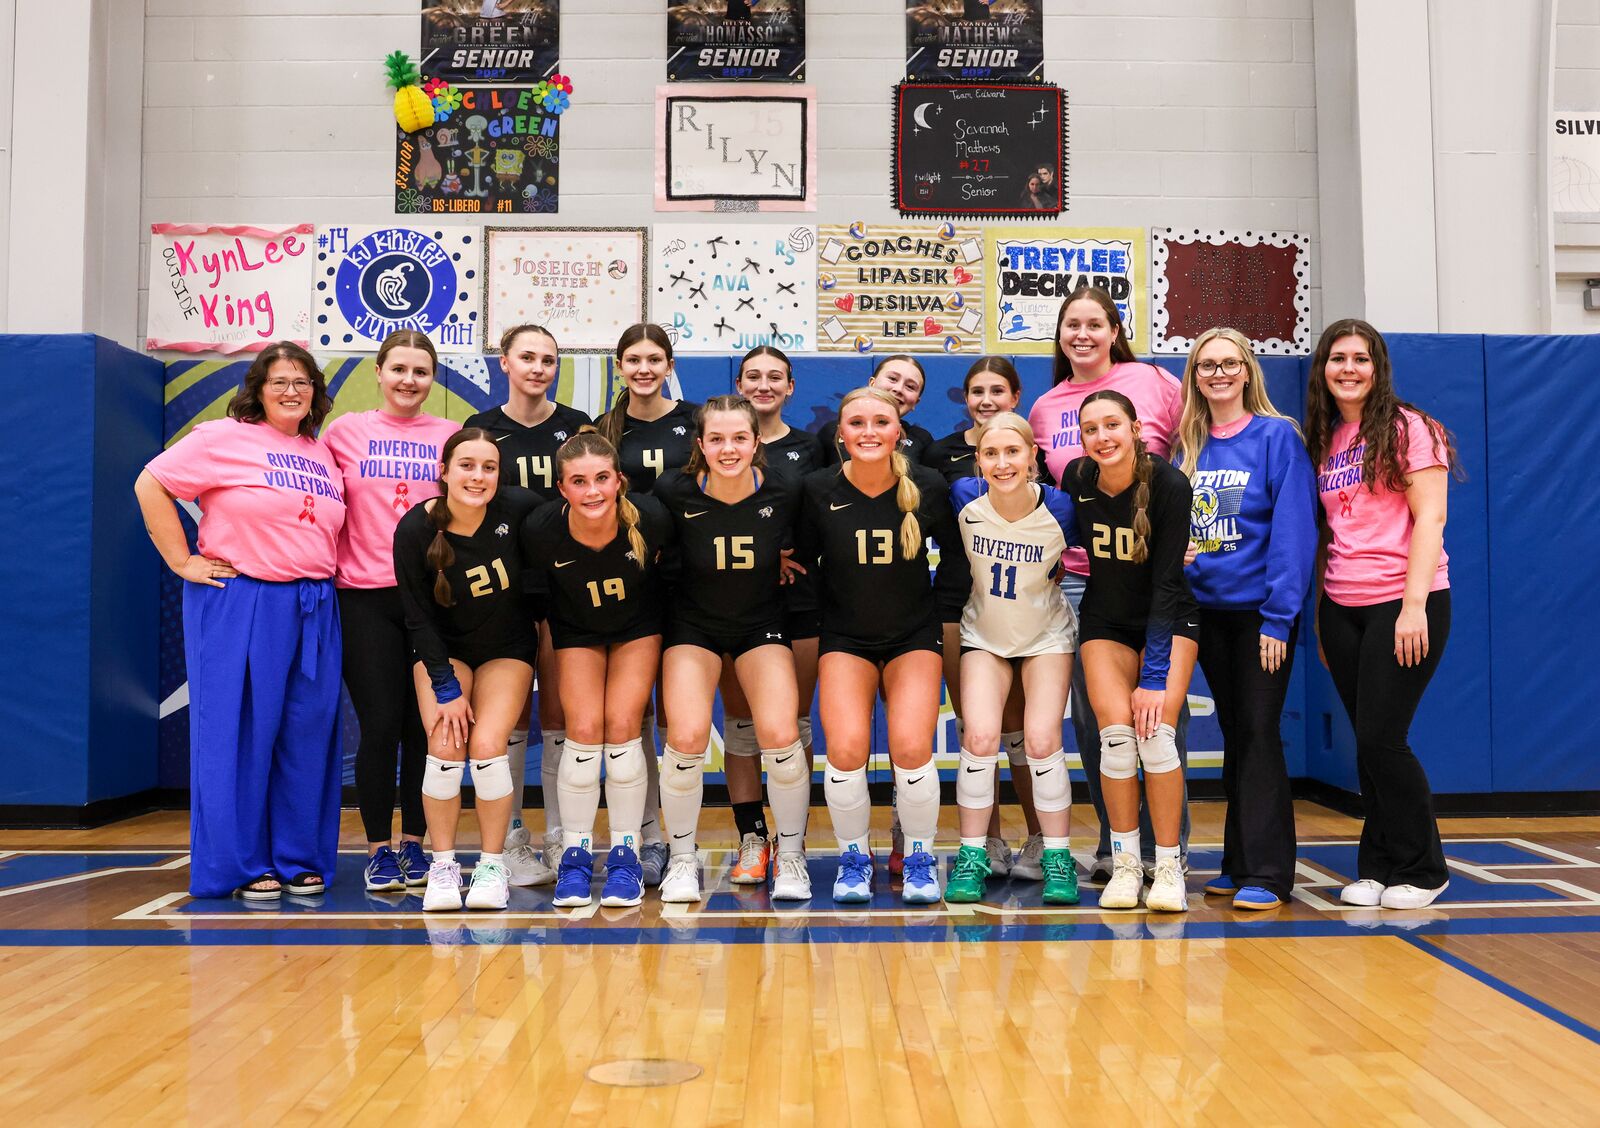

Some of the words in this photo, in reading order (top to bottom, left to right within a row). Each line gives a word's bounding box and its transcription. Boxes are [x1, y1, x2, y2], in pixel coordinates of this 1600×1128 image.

[453, 27, 538, 43] GREEN
[451, 49, 534, 68] SENIOR
[698, 48, 780, 67] SENIOR
[937, 49, 1019, 67] SENIOR
[722, 67, 753, 77] 2027
[961, 68, 992, 77] 2027
[462, 90, 532, 110] CHLOE
[949, 89, 973, 100] Team
[975, 88, 1006, 99] Edward
[488, 115, 557, 138] GREEN
[953, 118, 1010, 140] Savannah
[675, 104, 797, 188] RILYN
[955, 140, 1001, 158] Mathews
[395, 141, 414, 190] SENIOR
[961, 183, 998, 200] Senior
[432, 198, 481, 212] DS-LIBERO
[497, 199, 512, 212] #11
[317, 228, 349, 253] #14
[662, 239, 687, 256] #20
[845, 235, 959, 264] COACHES
[173, 236, 305, 288] KynLee
[345, 239, 372, 270] KJ
[1005, 246, 1126, 273] TREYLEE
[513, 257, 601, 276] JOSEIGH
[857, 267, 948, 285] LIPASEK
[162, 247, 199, 320] OUTSIDE
[532, 275, 589, 288] SETTER
[712, 274, 750, 292] AVA
[1002, 271, 1130, 301] DECKARD
[543, 292, 576, 308] #21
[199, 291, 274, 337] King
[732, 333, 805, 350] JUNIOR
[369, 440, 438, 460] RIVERTON
[266, 452, 330, 480] RIVERTON
[359, 459, 441, 483] VOLLEYBAL
[516, 455, 553, 489] 14
[642, 448, 664, 479] 4
[264, 471, 342, 503] VOLLEYBALL
[713, 535, 755, 570] 15
[855, 529, 894, 564] 13
[972, 535, 1044, 563] RIVERTON
[1092, 523, 1135, 561] 20
[1223, 542, 1237, 552] 25
[465, 558, 510, 598] 21
[989, 562, 1017, 600] 11
[586, 577, 626, 608] 19
